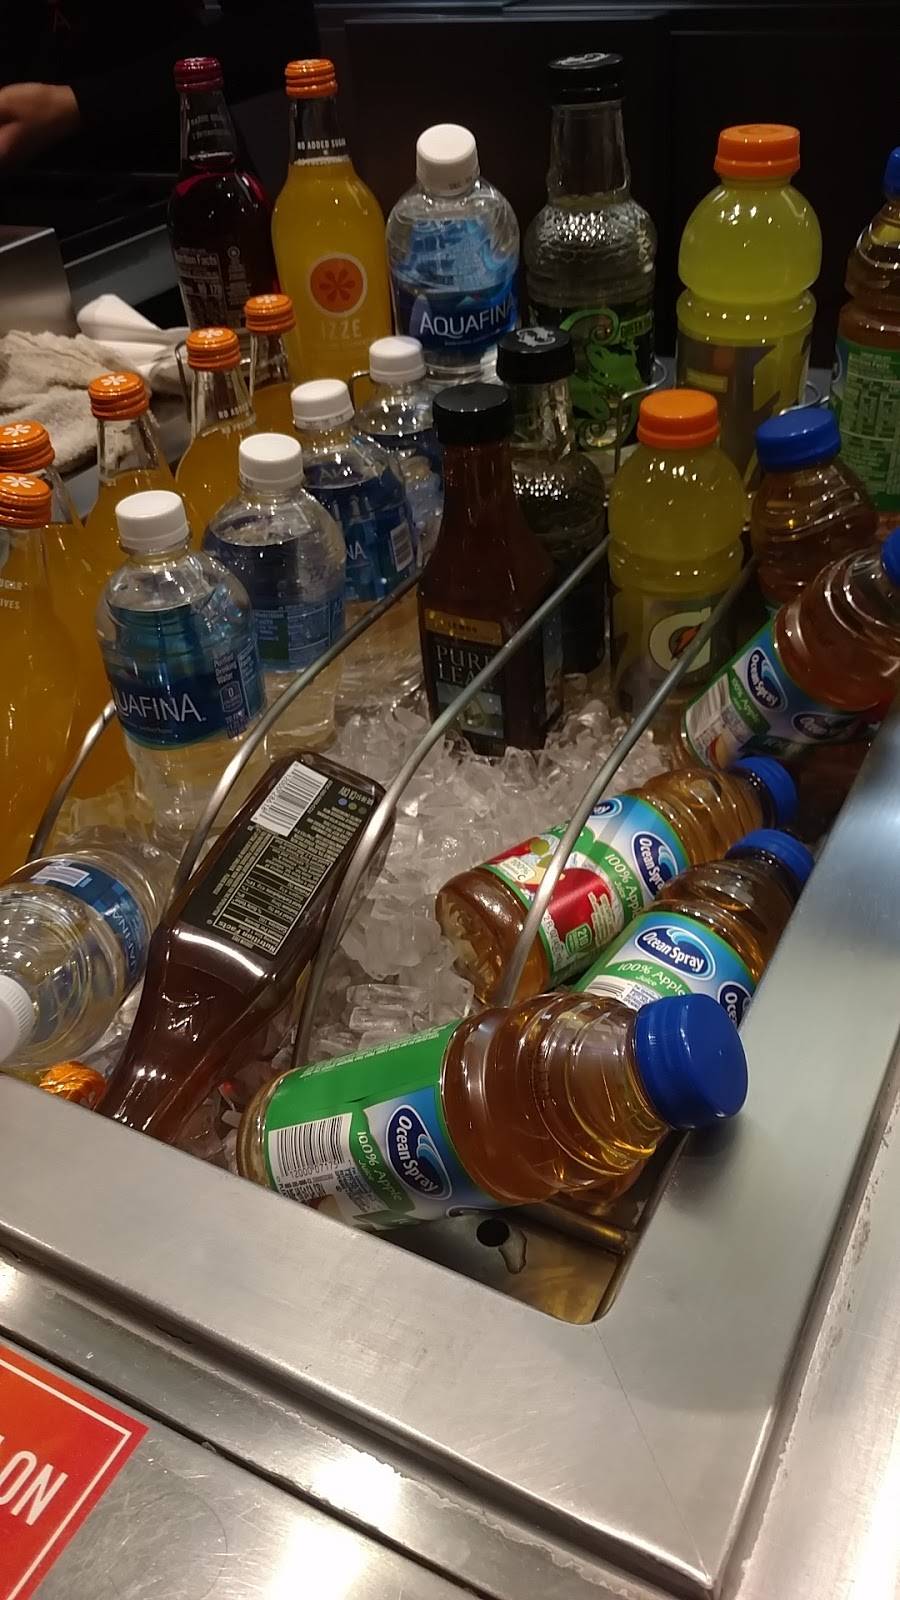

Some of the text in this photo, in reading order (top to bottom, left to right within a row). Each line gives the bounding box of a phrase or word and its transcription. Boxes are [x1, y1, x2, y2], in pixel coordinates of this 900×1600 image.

[307, 140, 330, 150] ADDED
[320, 318, 362, 340] IZZE
[419, 293, 516, 339] AQUAFINA
[114, 687, 204, 722] UAFINA
[605, 853, 634, 883] 100%
[639, 837, 656, 871] Ocean
[217, 920, 240, 934] Facts
[241, 931, 276, 951] Nutrition
[642, 932, 705, 972] Ocean Spray
[617, 963, 686, 997] 100% Apple
[725, 992, 737, 1024] Oce
[357, 1131, 379, 1166] 100%
[396, 1115, 439, 1192] Ocean Spray
[0, 1449, 69, 1527] ON
